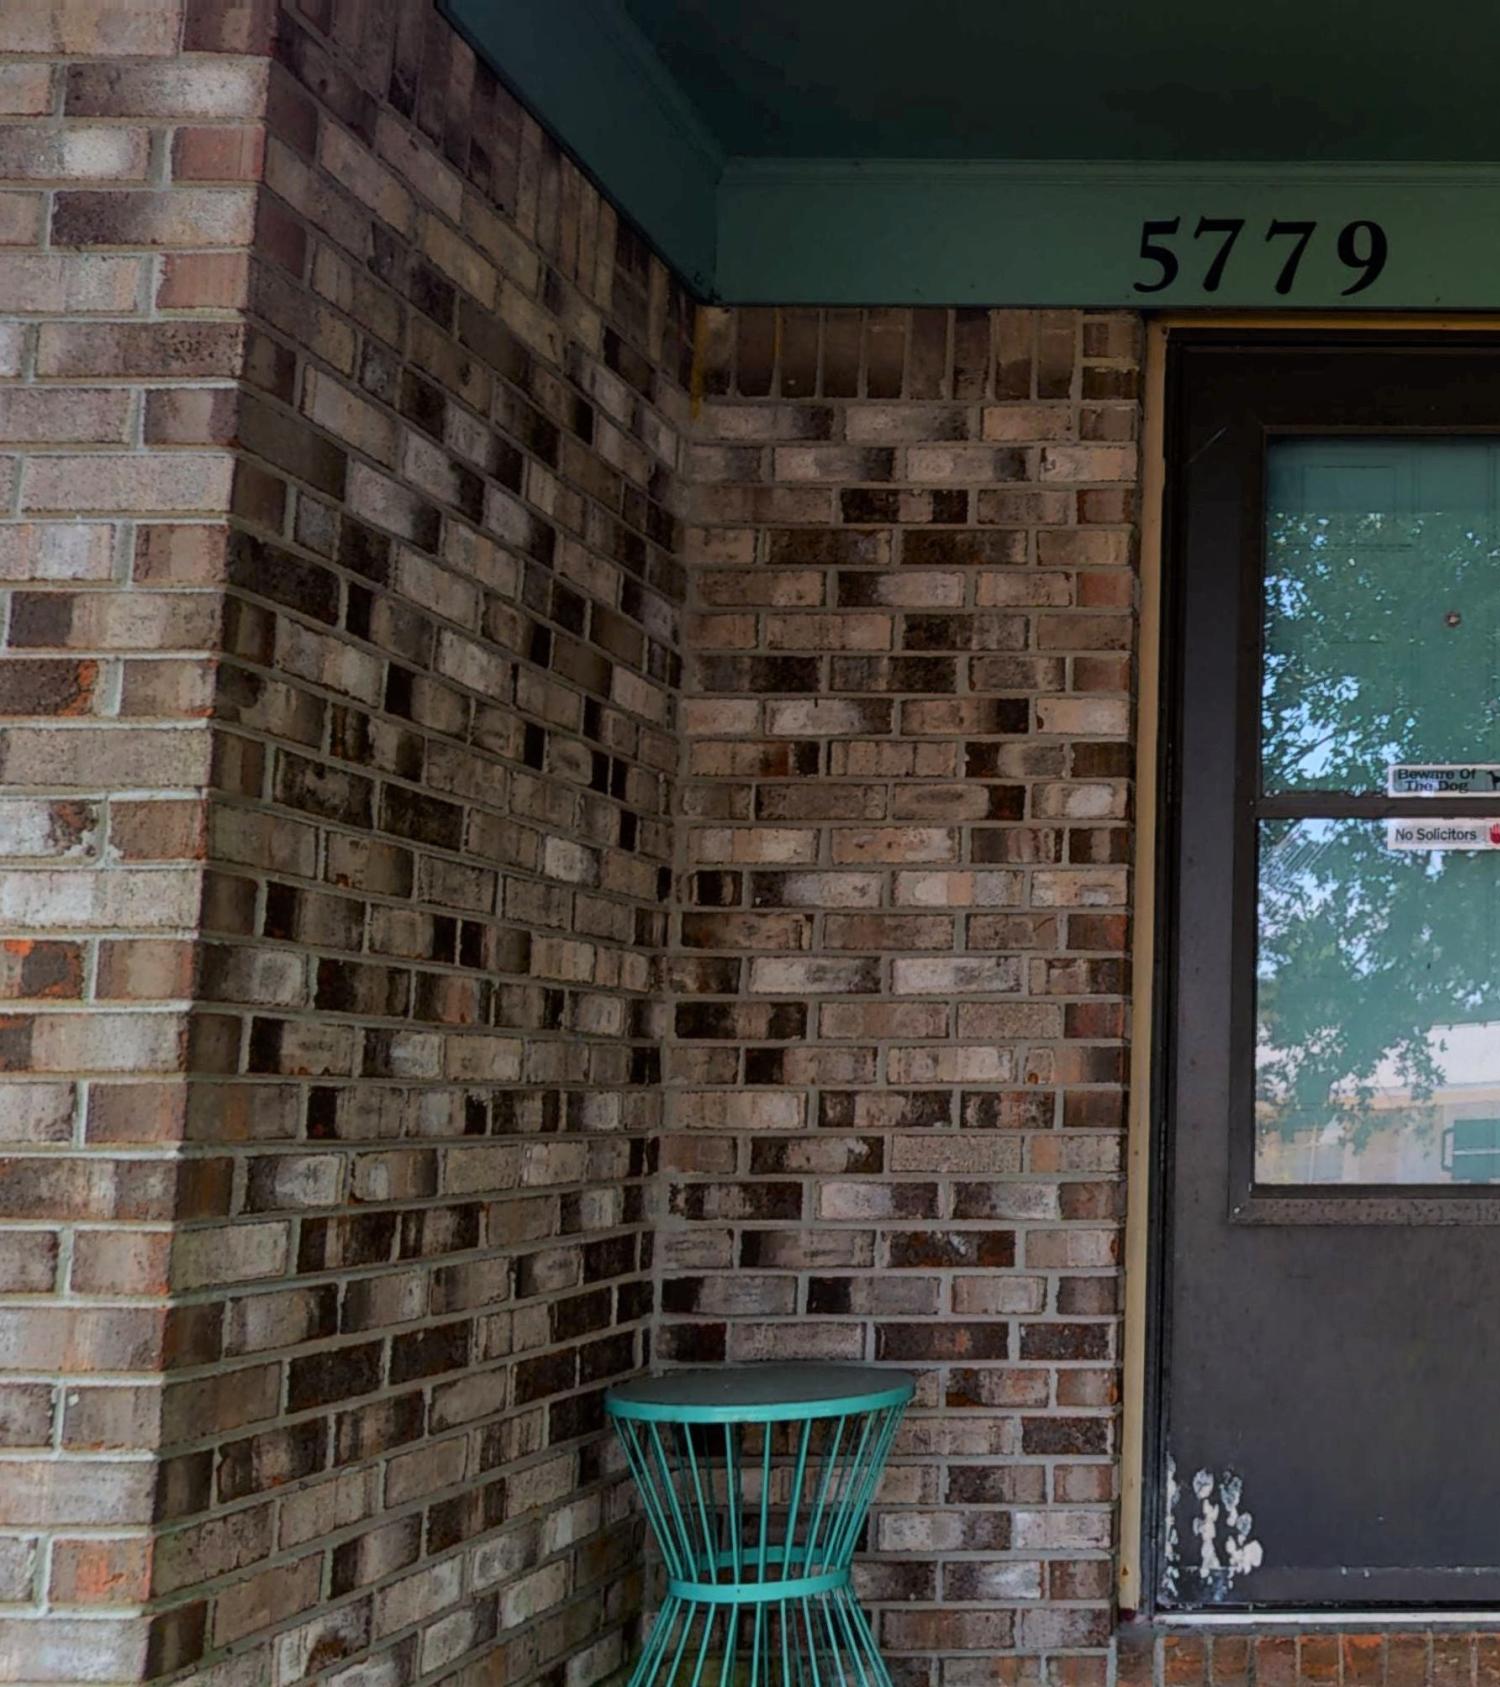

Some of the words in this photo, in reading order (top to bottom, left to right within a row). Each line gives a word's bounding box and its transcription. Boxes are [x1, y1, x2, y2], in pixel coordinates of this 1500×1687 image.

[1132, 215, 1388, 297] 5779
[1397, 768, 1455, 780] Beware
[1460, 768, 1477, 780] Of
[1405, 780, 1434, 791] The
[1438, 780, 1469, 793] Dog
[1395, 828, 1414, 841] No
[1416, 827, 1478, 841] Solicitors
